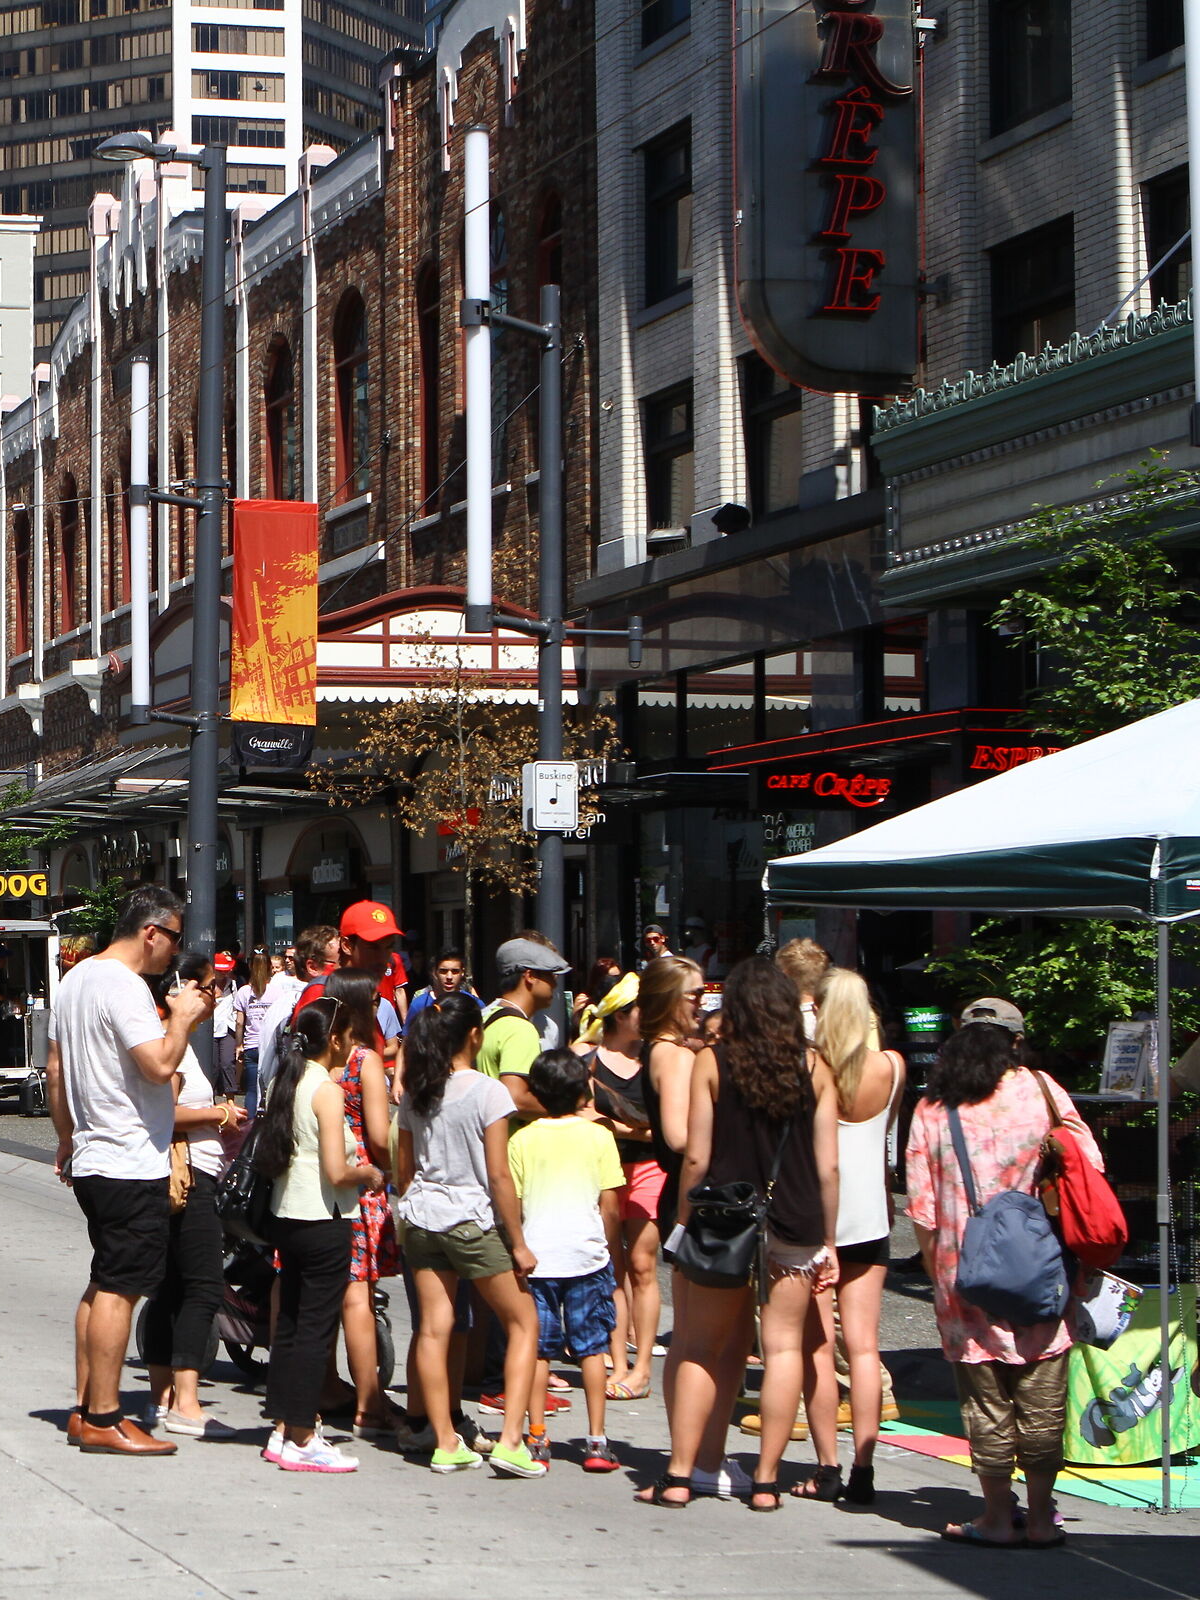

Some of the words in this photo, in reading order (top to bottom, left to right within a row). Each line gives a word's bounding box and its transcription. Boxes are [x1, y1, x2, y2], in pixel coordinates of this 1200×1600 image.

[817, 0, 913, 311] RÊPE
[248, 736, 293, 751] Granville
[539, 769, 573, 781] Busking
